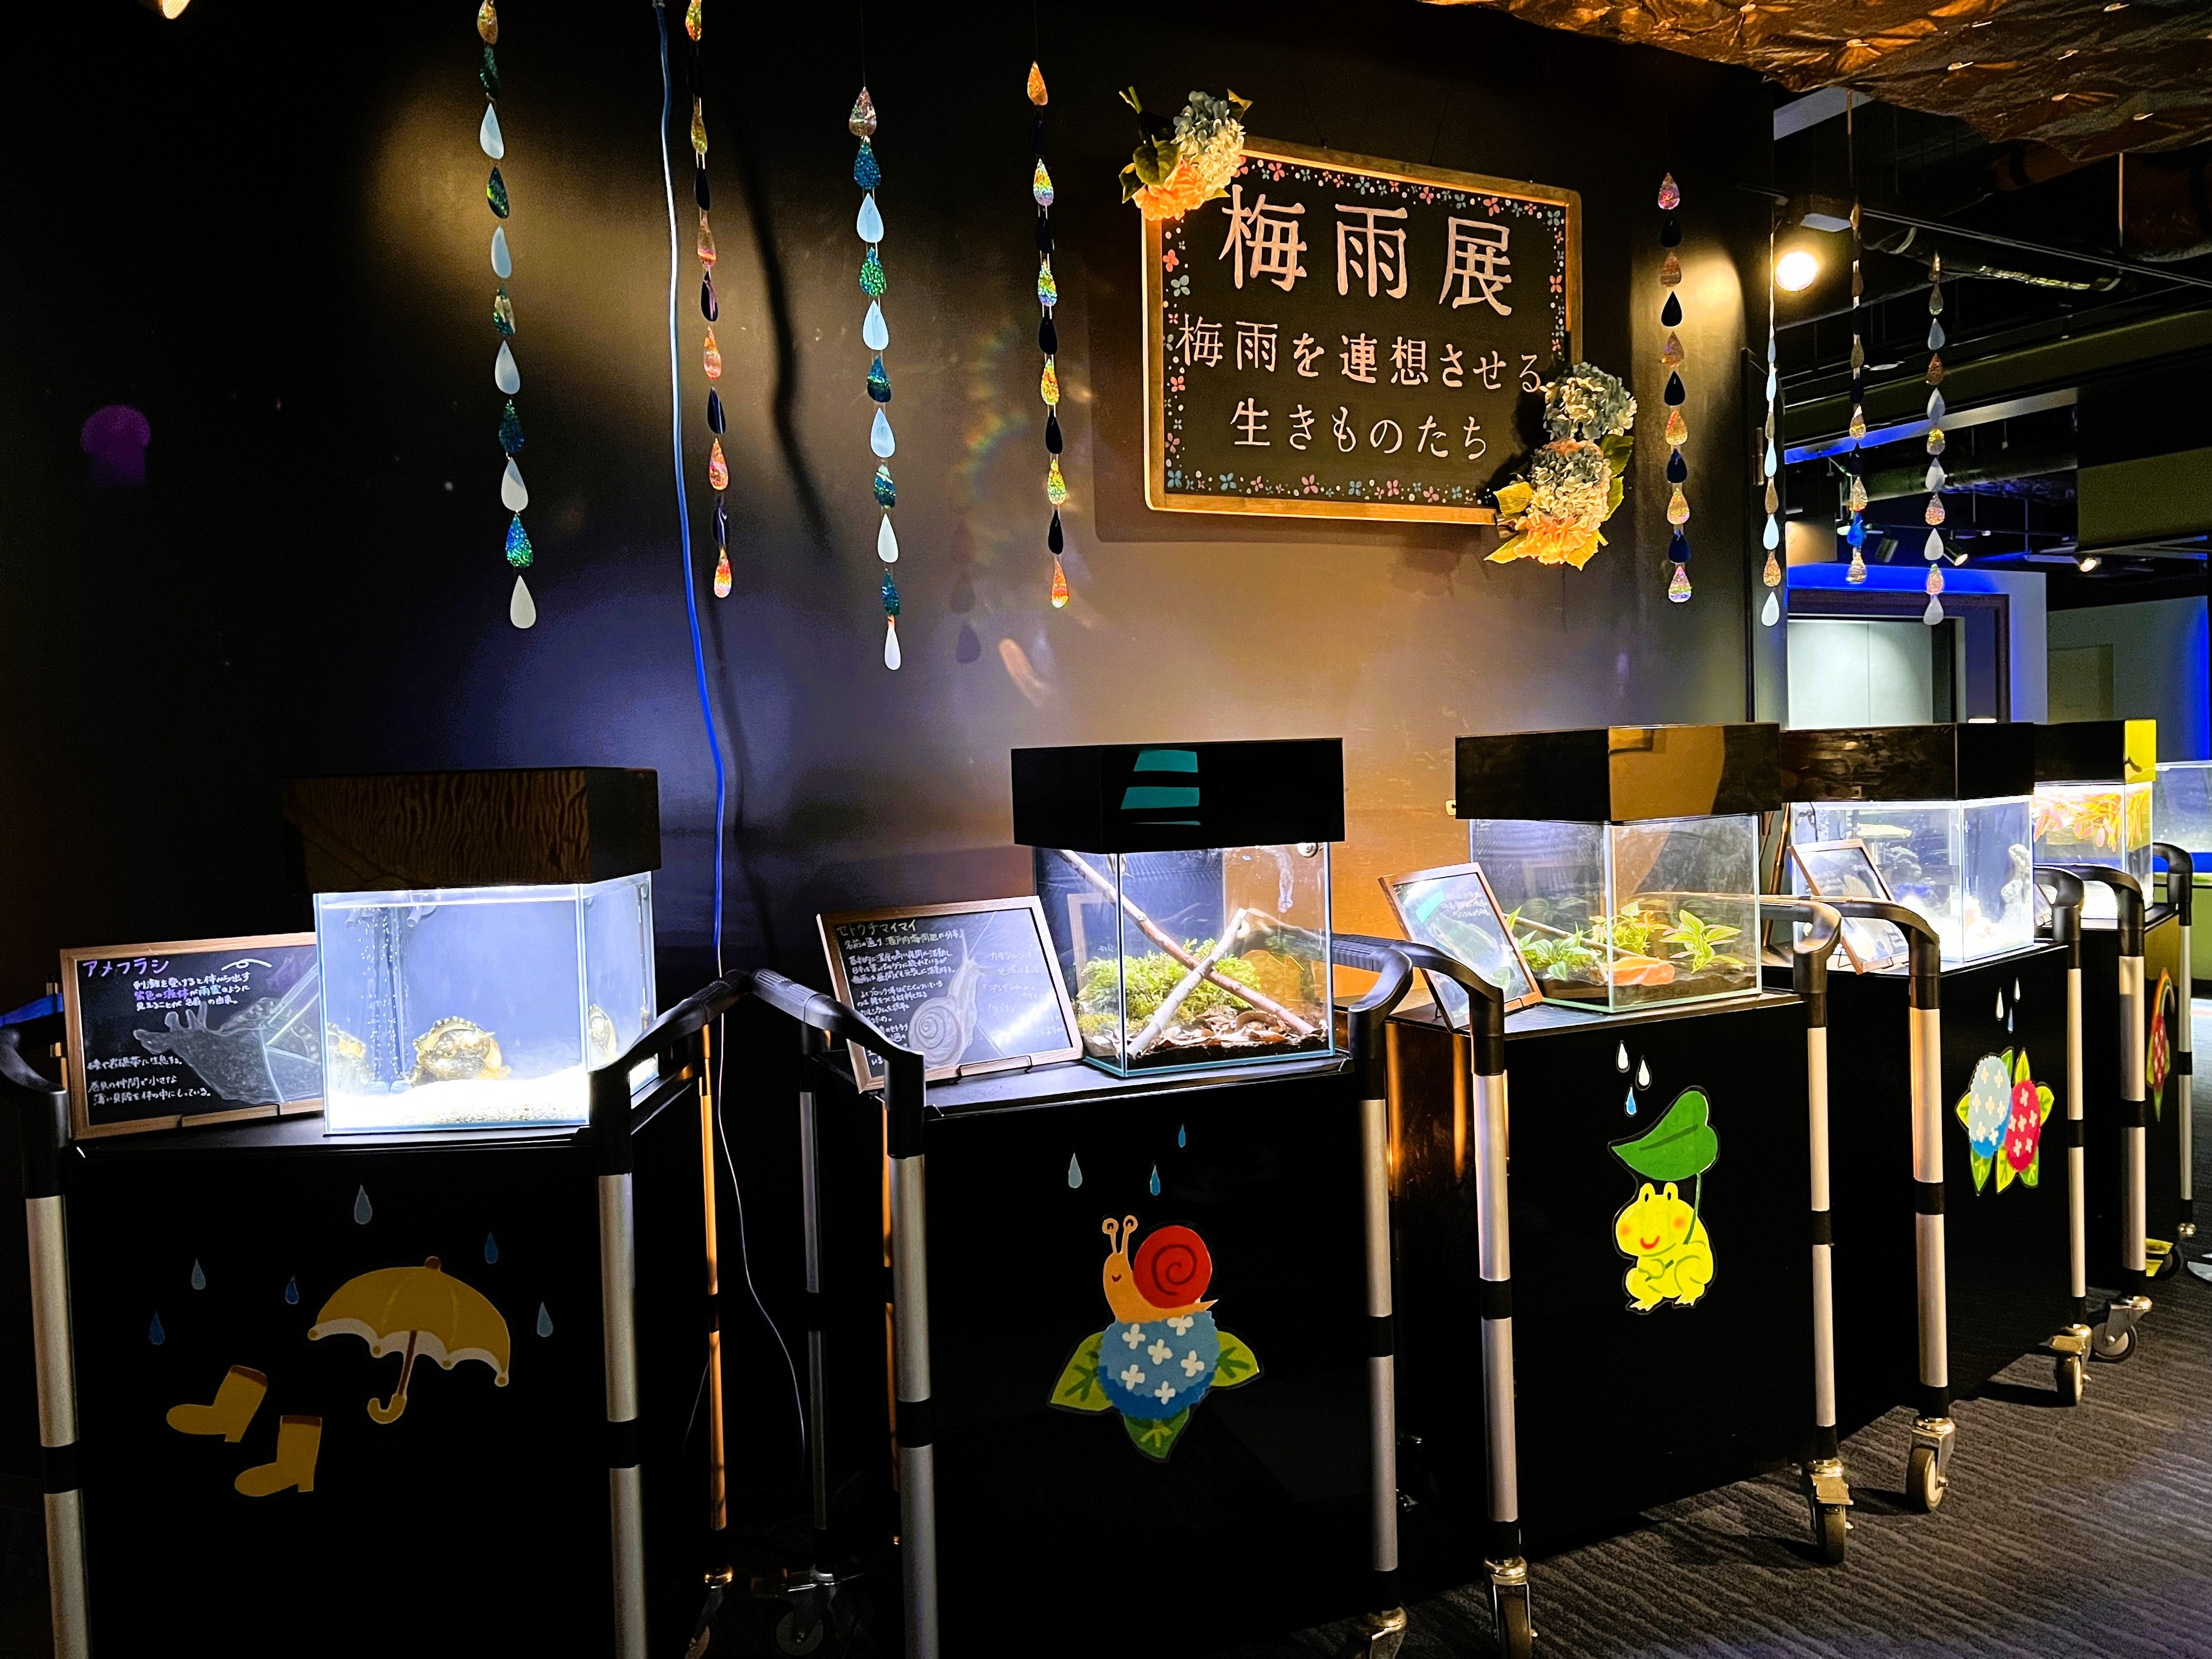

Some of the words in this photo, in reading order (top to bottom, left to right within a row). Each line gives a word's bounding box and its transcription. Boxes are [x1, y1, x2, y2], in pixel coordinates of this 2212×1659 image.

[1219, 184, 1513, 316] 梅雨展
[1176, 313, 1543, 392] 梅雨を連想させる
[1230, 397, 1488, 461] 生きものたち
[837, 919, 916, 936] セトウチマイマイ
[82, 957, 169, 978] アメフラシ
